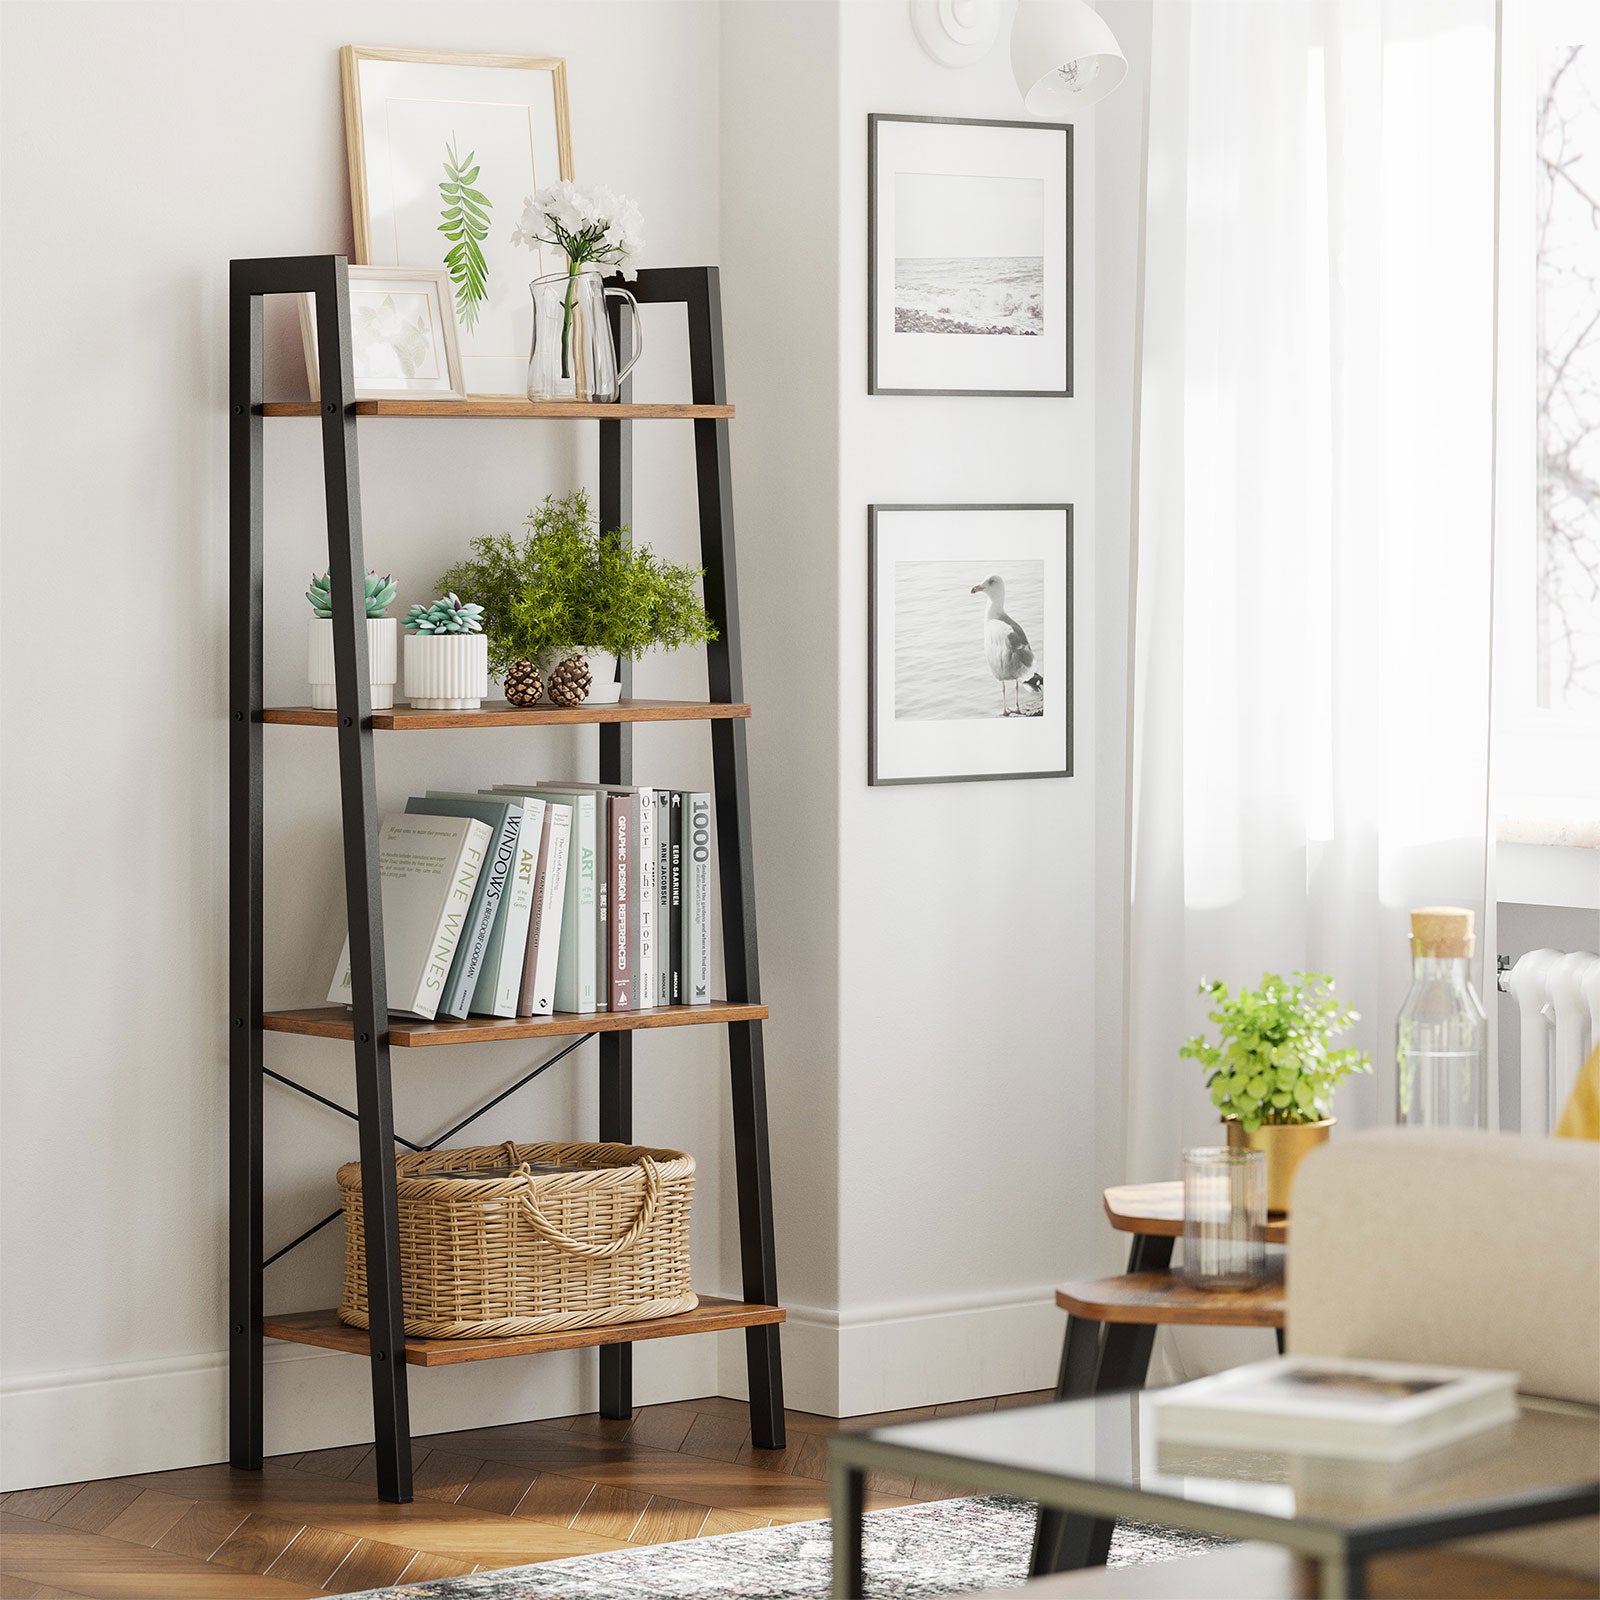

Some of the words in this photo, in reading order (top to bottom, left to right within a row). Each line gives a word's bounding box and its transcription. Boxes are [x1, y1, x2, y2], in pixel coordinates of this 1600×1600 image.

[618, 815, 627, 861] GRAPHIC
[642, 795, 650, 846] Over
[693, 800, 709, 863] 1000
[486, 815, 522, 900] WINDOWS
[519, 849, 533, 885] ART
[582, 848, 594, 881] ART
[660, 842, 668, 863] ARNE
[672, 844, 680, 865] EERO
[453, 847, 481, 903] FINE
[538, 871, 546, 894] FRANK
[618, 863, 627, 901] DESIGN
[642, 863, 650, 899] the
[660, 866, 668, 906] JACOBSEN
[672, 866, 680, 906] SAARINEN
[477, 908, 493, 942] BERGDORF
[618, 903, 627, 971] REFERENCED
[642, 912, 650, 956] Top
[426, 914, 462, 992] WINES
[466, 943, 482, 979] GOODMAN
